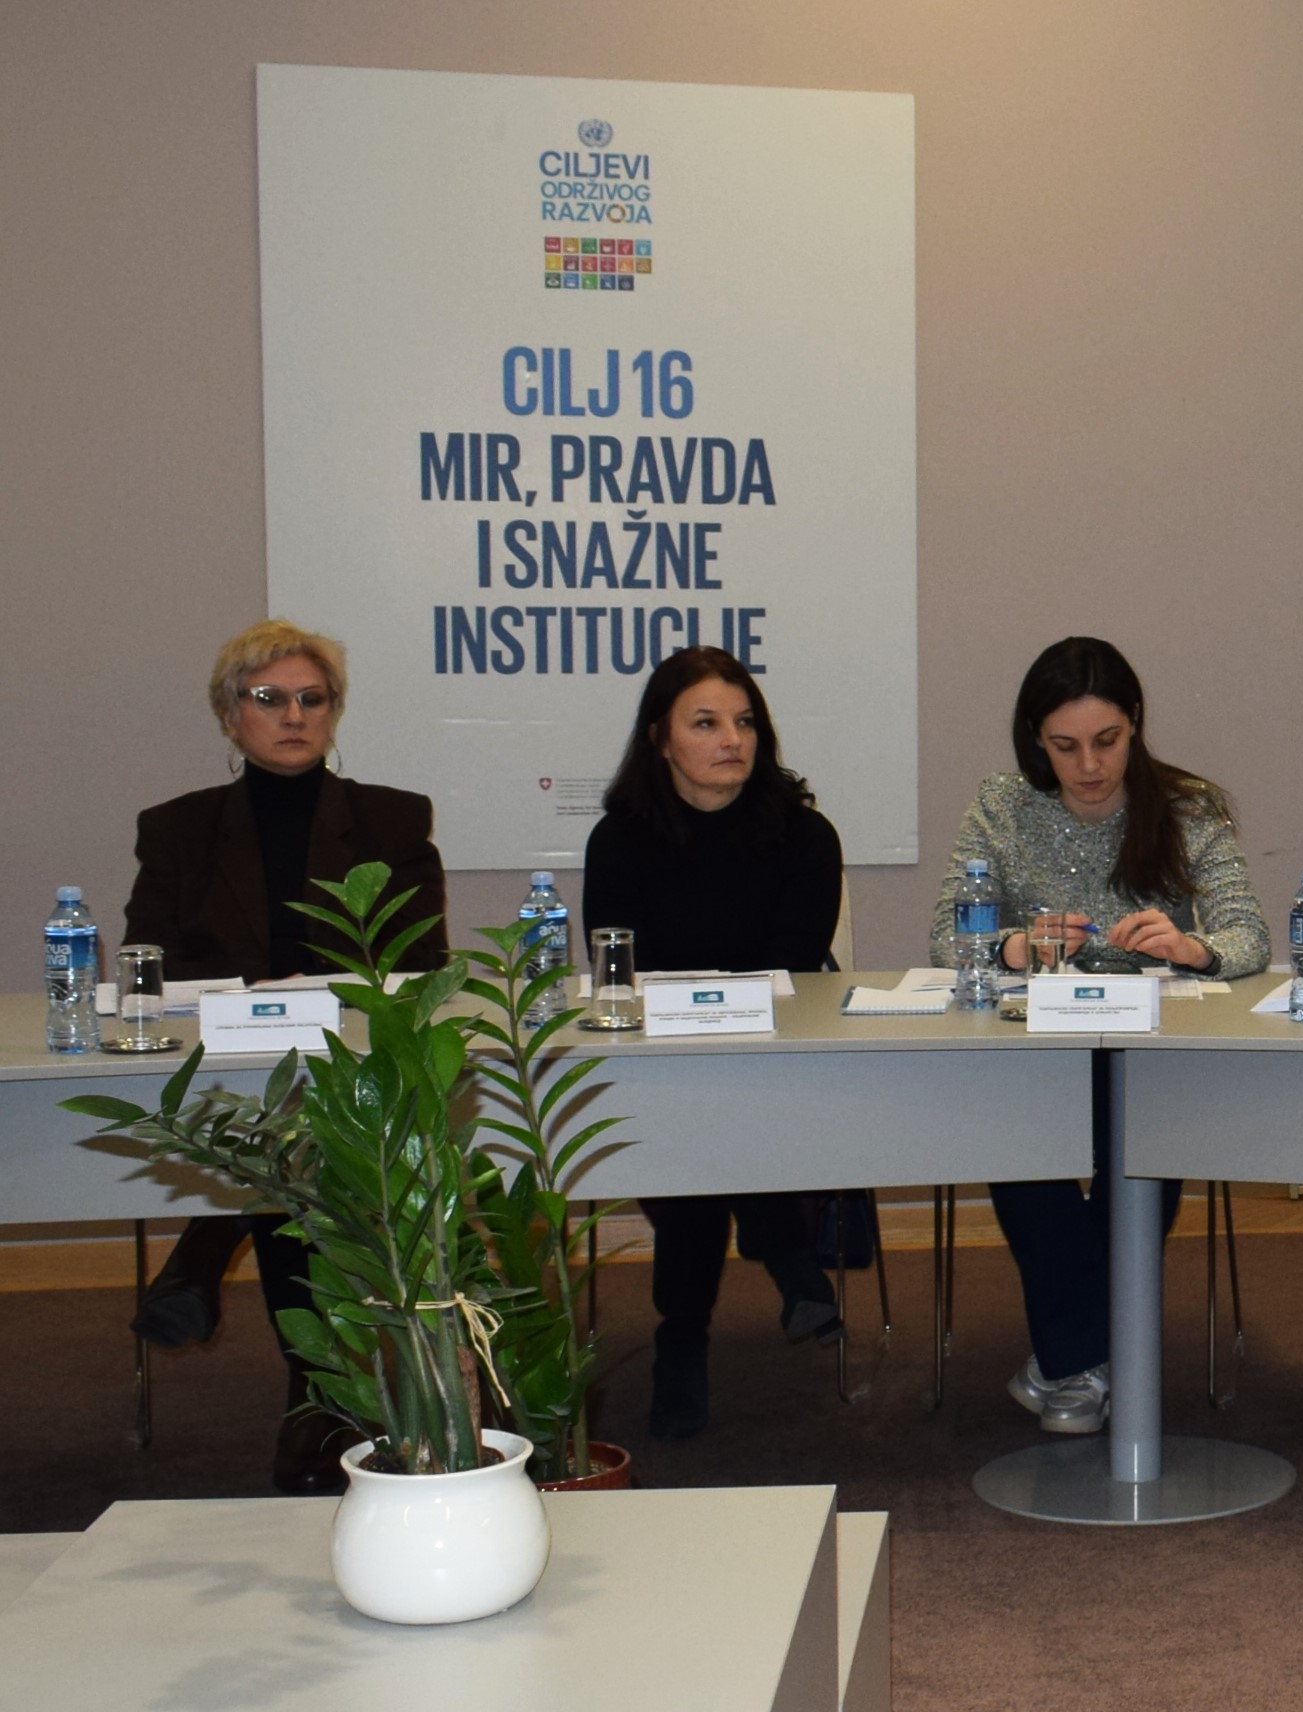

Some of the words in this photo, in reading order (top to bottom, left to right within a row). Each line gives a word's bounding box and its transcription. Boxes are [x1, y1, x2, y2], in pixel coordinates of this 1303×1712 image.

[539, 151, 650, 179] CILJEVI
[541, 178, 651, 202] ODRŽIVOG
[541, 201, 652, 224] RAZVOJA
[503, 346, 620, 418] CILJ
[632, 350, 694, 419] 16
[420, 432, 537, 507] MIR,
[550, 434, 777, 506] PRAVDA
[477, 519, 492, 588] I
[503, 509, 723, 590] SNAŽNE
